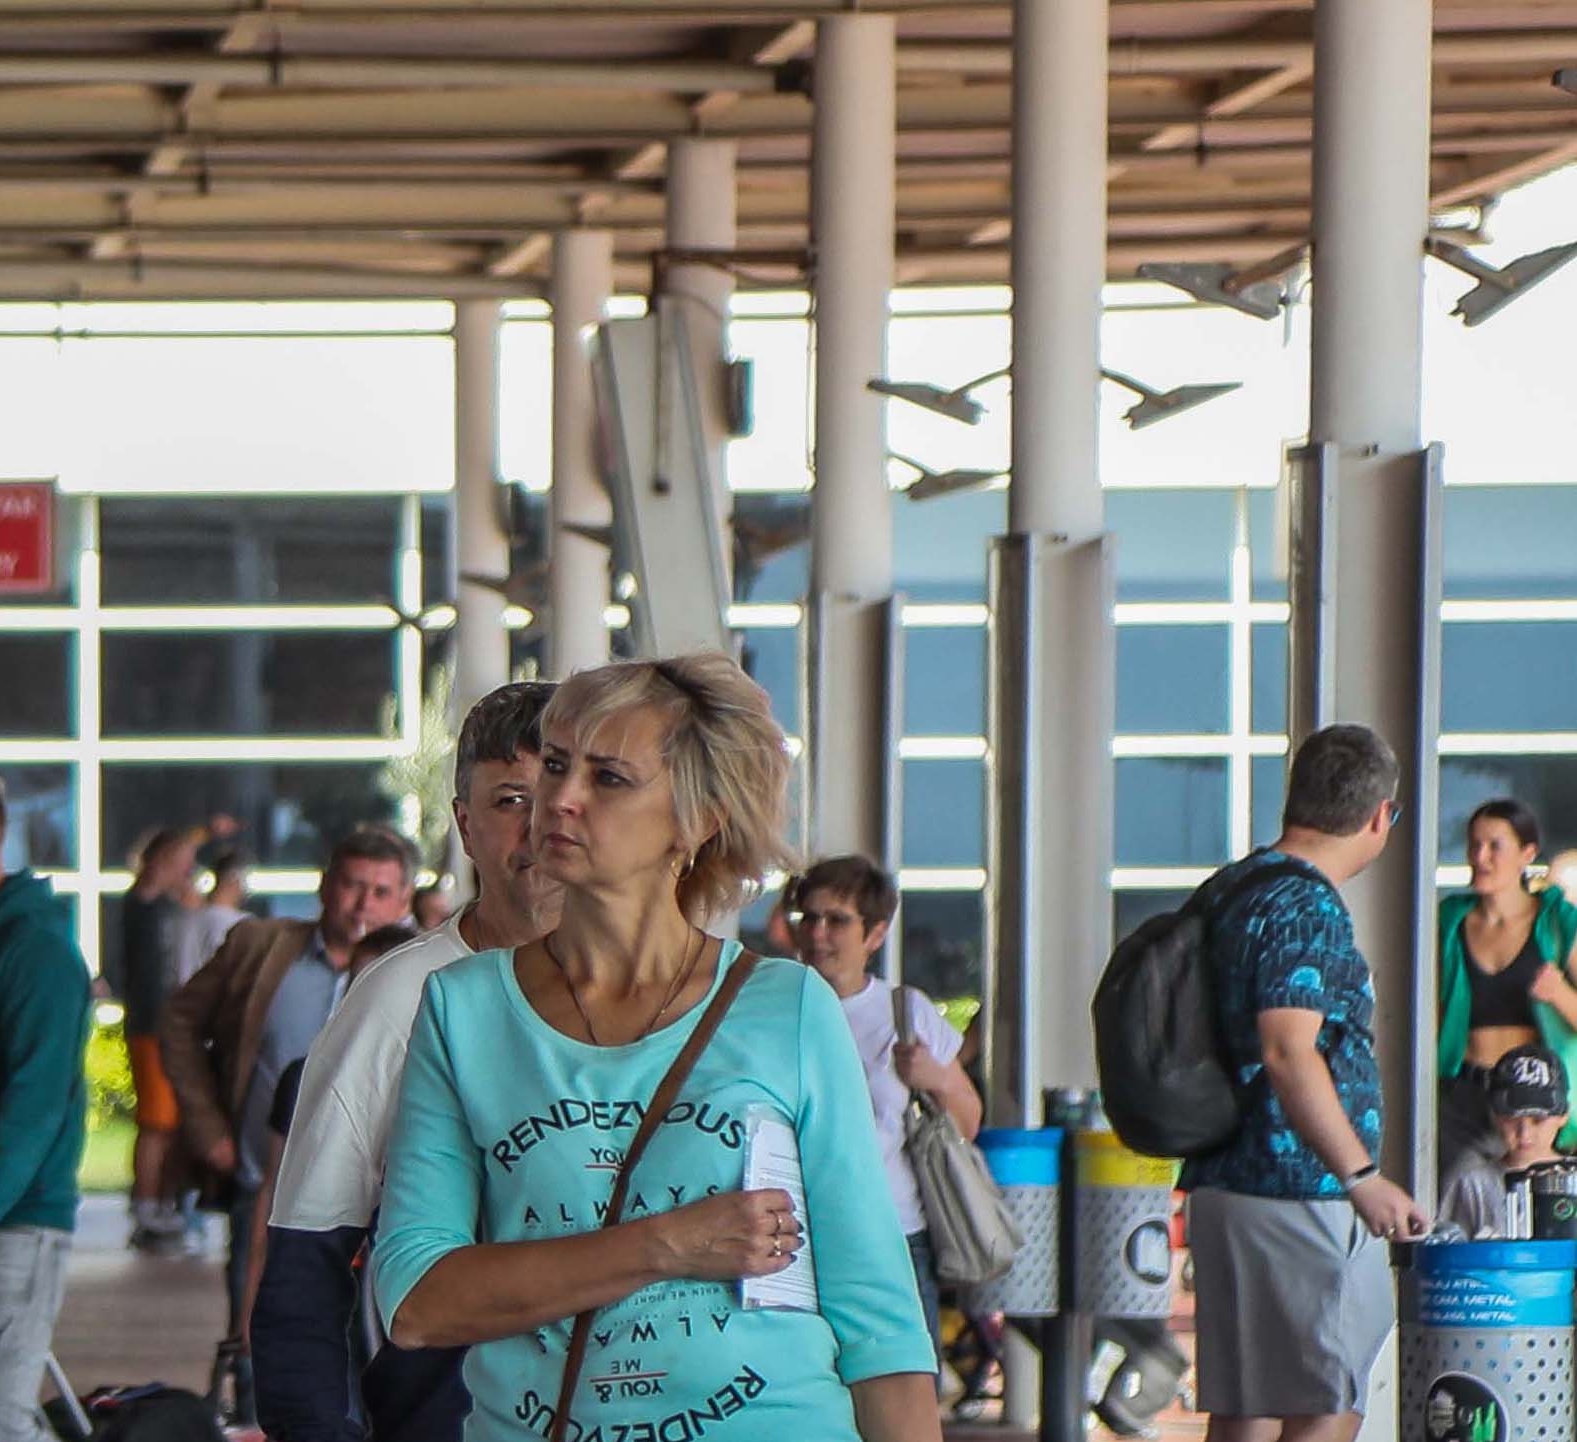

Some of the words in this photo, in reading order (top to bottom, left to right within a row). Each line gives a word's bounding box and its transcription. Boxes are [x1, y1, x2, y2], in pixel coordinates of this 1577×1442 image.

[535, 1312, 732, 1354] ALWAS
[610, 1358, 642, 1375] ME
[621, 1378, 664, 1398] YOU
